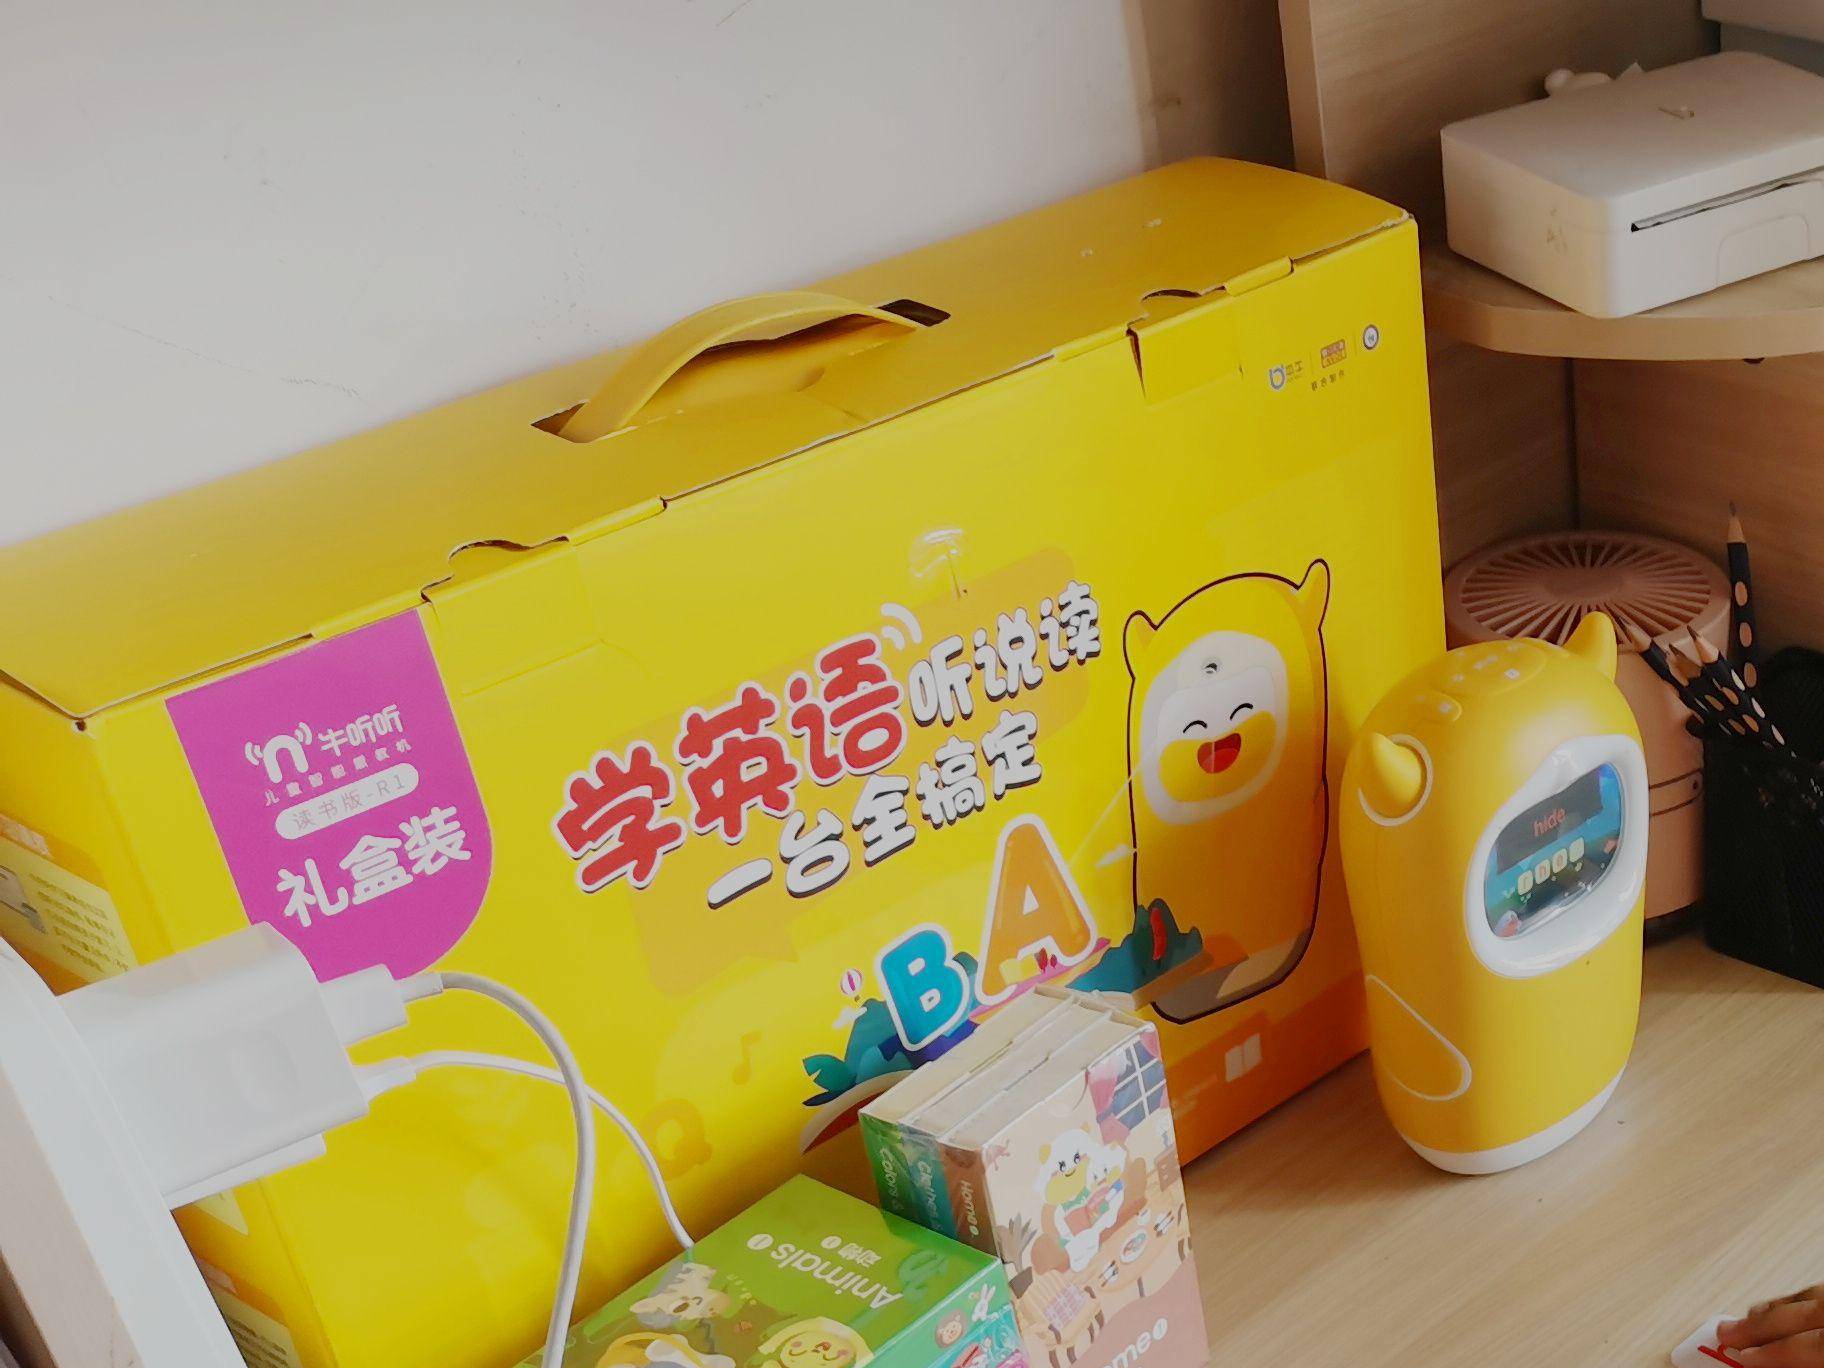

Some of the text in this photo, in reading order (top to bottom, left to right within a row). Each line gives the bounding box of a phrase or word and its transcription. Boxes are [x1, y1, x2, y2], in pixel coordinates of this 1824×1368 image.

[318, 704, 403, 757] 牛听听
[553, 580, 1101, 892] 学英语 听说读
[707, 708, 1043, 910] 一台全搞定
[1533, 807, 1566, 836] hide
[275, 805, 472, 928] 礼盒装
[960, 1180, 979, 1225] Home
[770, 1243, 904, 1310] Animals
